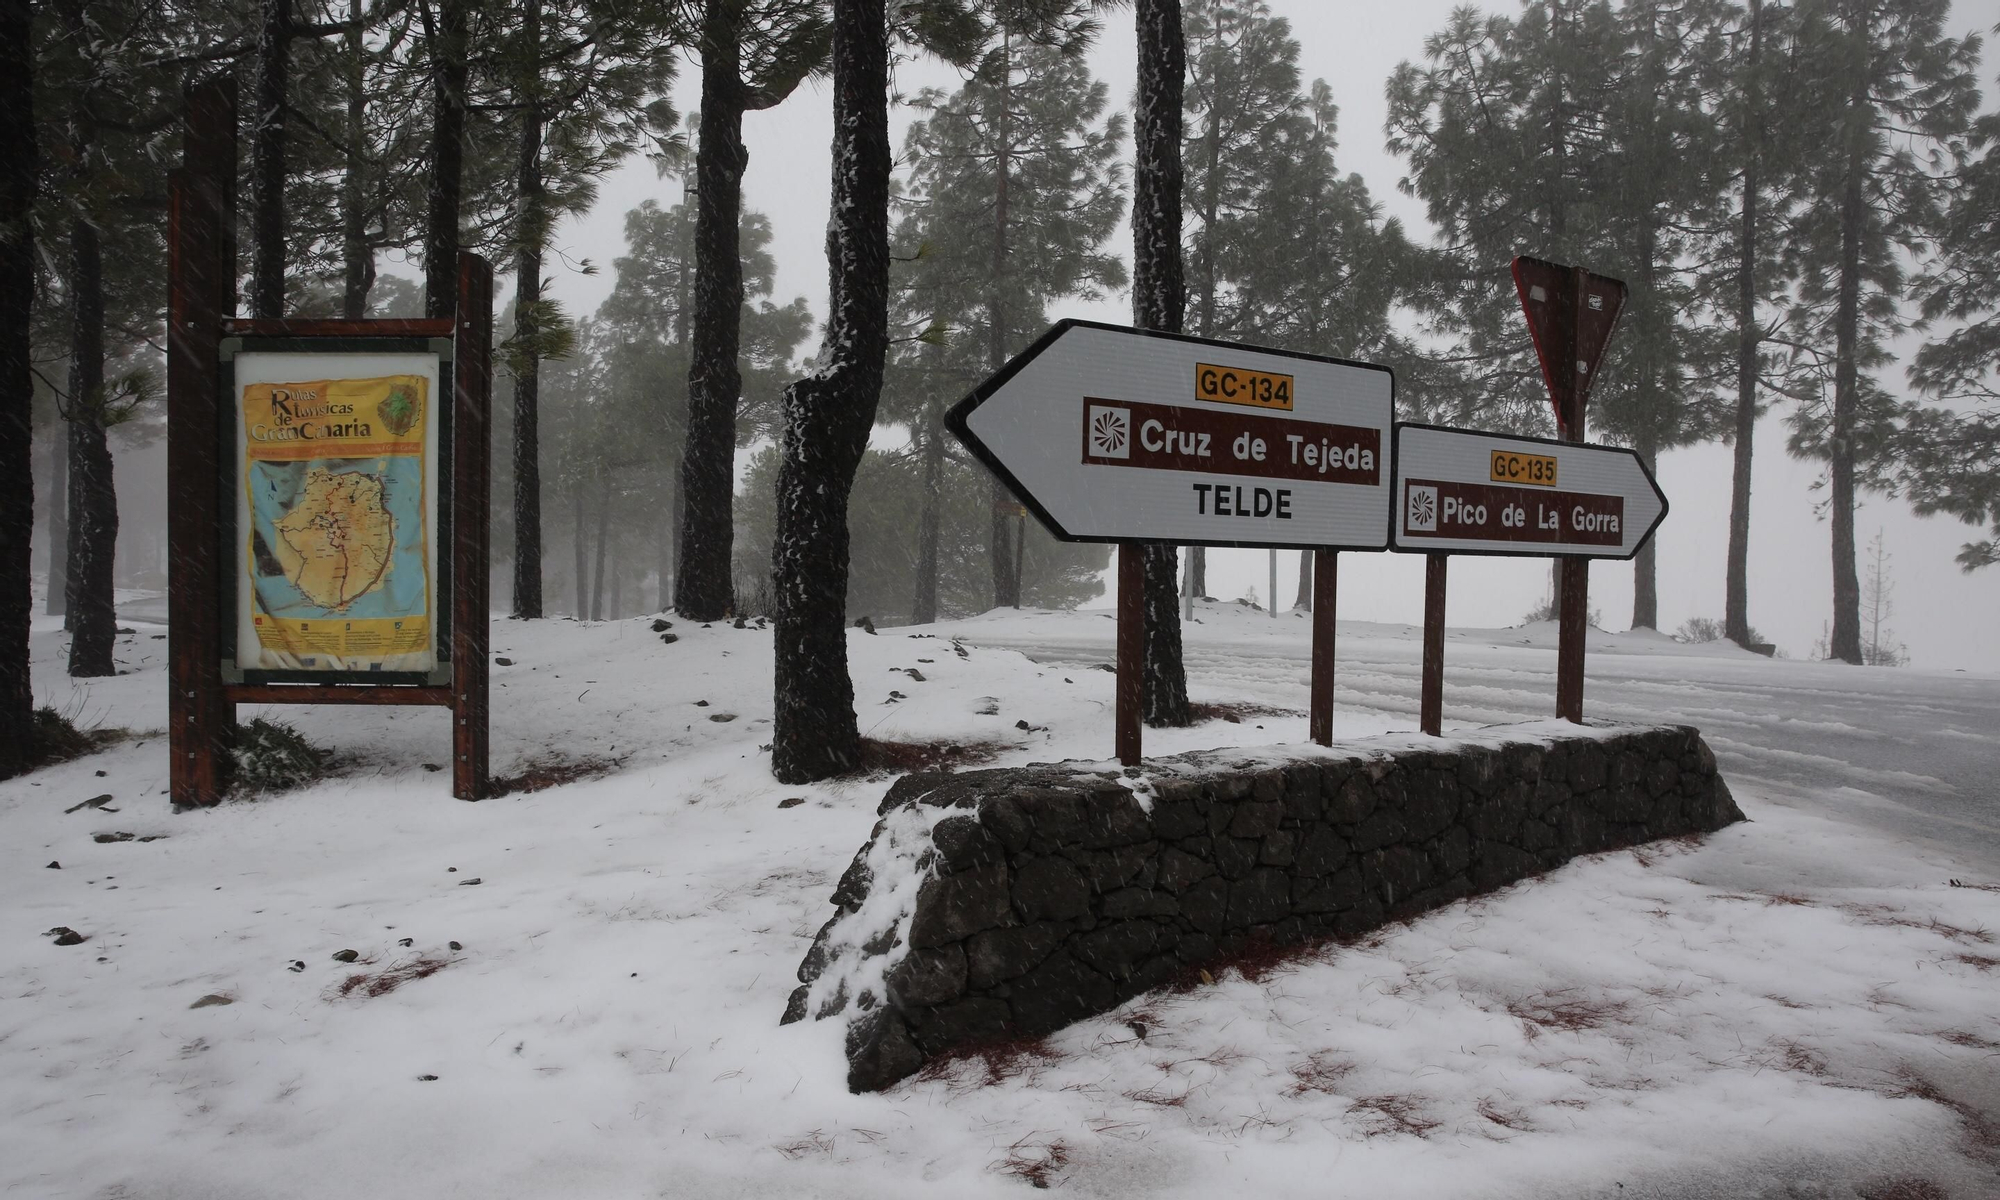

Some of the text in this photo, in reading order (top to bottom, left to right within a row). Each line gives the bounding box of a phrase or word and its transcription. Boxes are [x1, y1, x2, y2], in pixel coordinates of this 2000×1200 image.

[271, 389, 317, 416] Rutas
[1201, 370, 1289, 404] GC-134
[274, 413, 292, 426] de
[1140, 418, 1375, 474] Cruz de Tejeda
[1494, 455, 1554, 480] GC-135
[1192, 483, 1292, 519] TELDE
[1443, 496, 1619, 533] Pico de La Gorra
